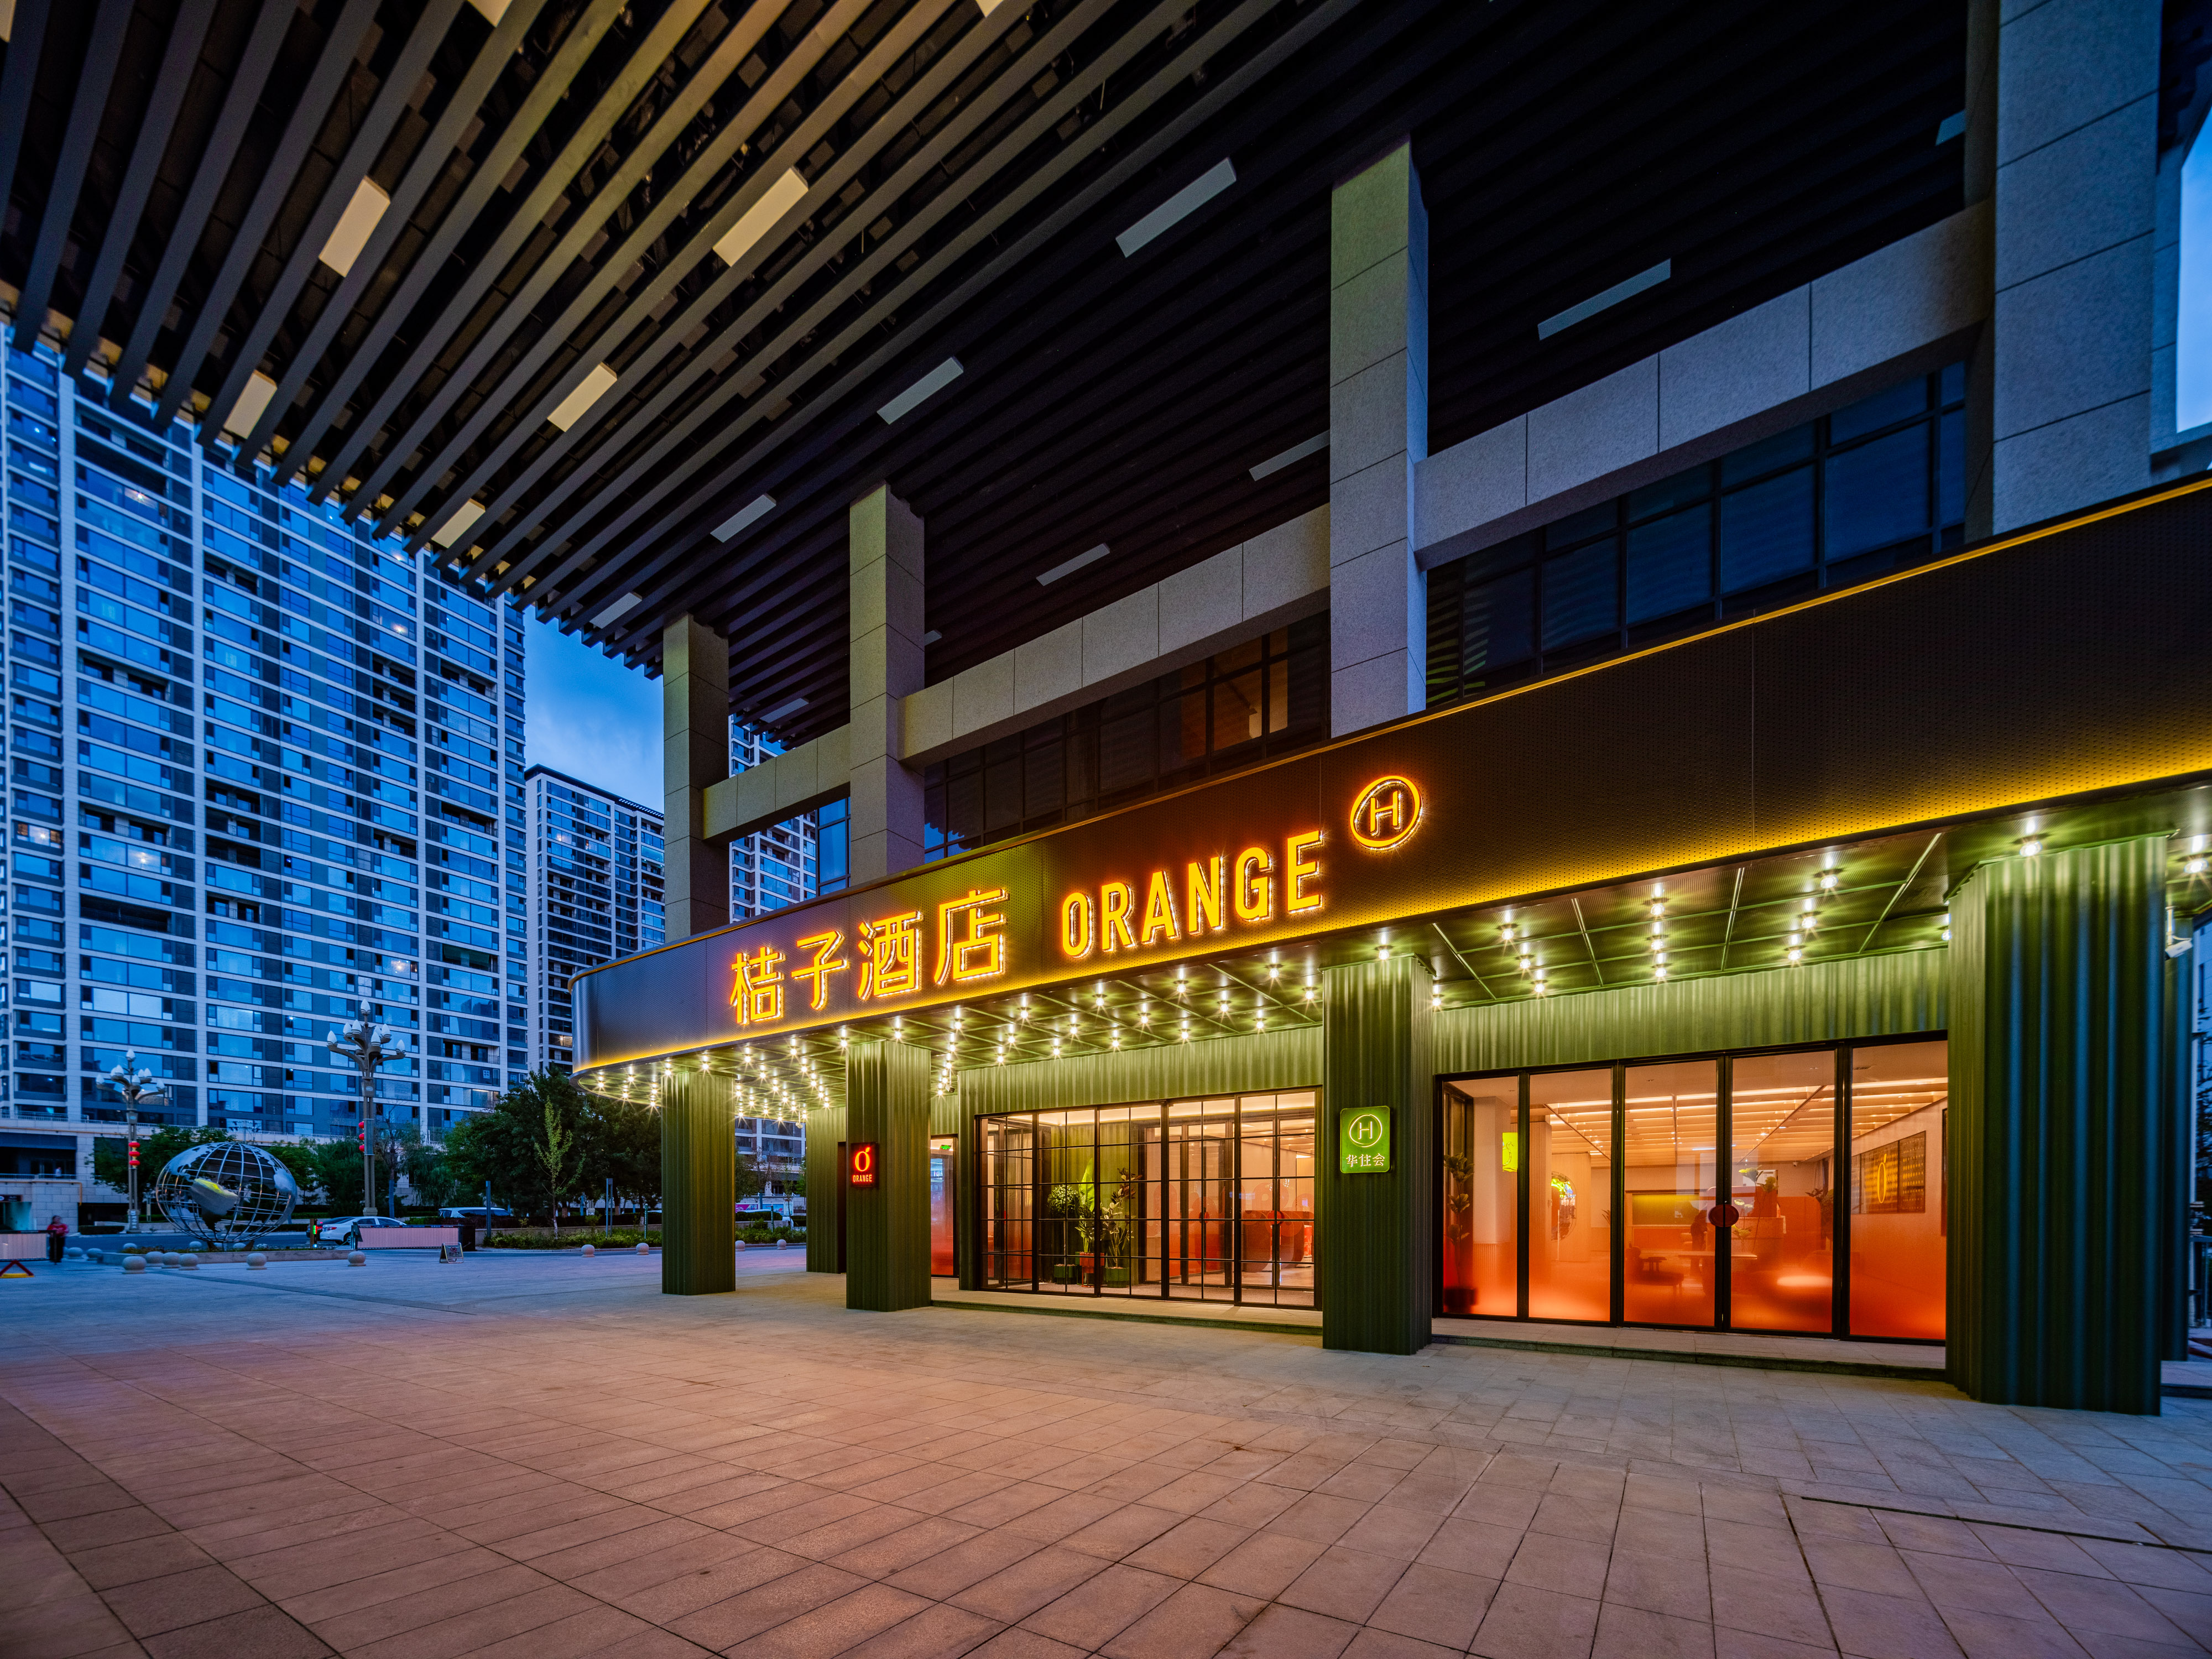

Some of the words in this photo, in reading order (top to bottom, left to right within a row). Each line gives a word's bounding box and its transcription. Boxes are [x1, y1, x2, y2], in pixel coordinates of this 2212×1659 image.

[1370, 790, 1402, 836] H
[1061, 830, 1323, 959] ORANGE
[731, 889, 1009, 1025] 桔子酒店
[1358, 1121, 1373, 1139] H
[1346, 1153, 1385, 1167] 华住会
